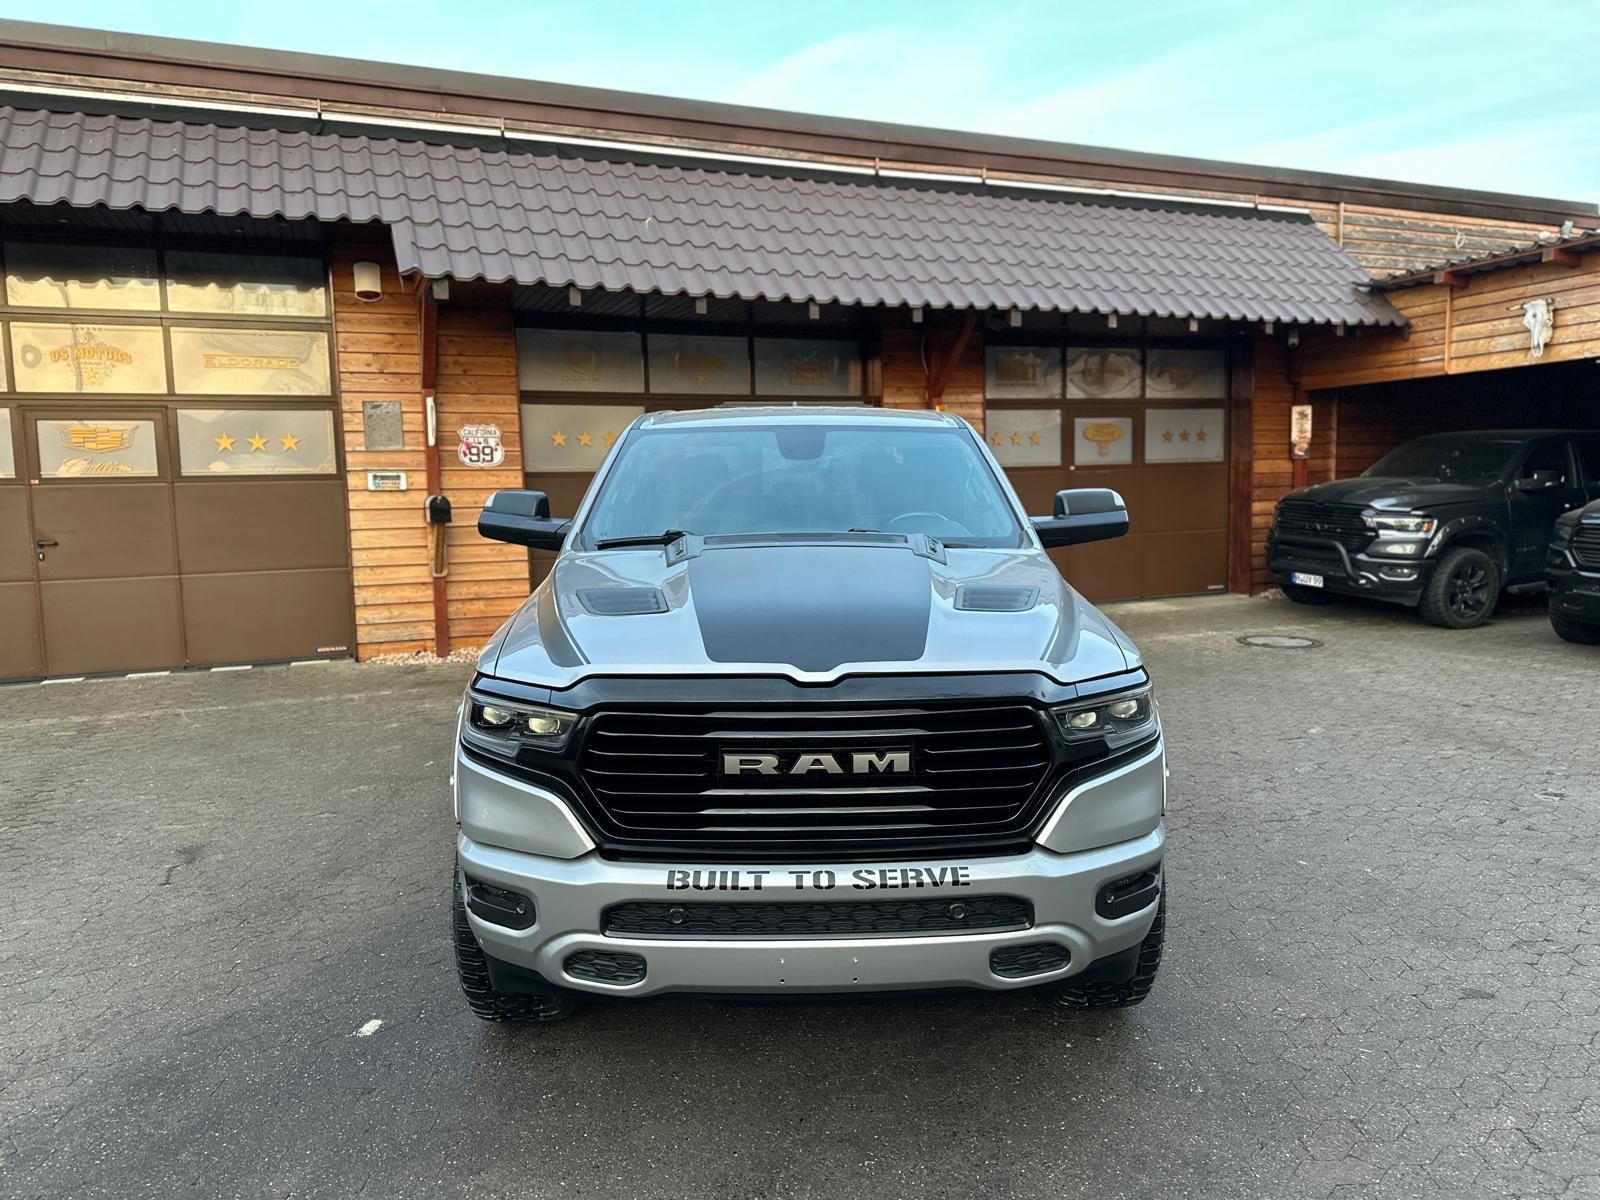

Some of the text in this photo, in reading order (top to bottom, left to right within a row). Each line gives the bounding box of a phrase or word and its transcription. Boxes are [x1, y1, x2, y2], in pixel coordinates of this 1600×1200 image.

[73, 346, 133, 365] MOTORS
[469, 446, 494, 463] 99
[723, 751, 910, 775] RAM
[666, 866, 971, 891] BUILT TO SERVE
